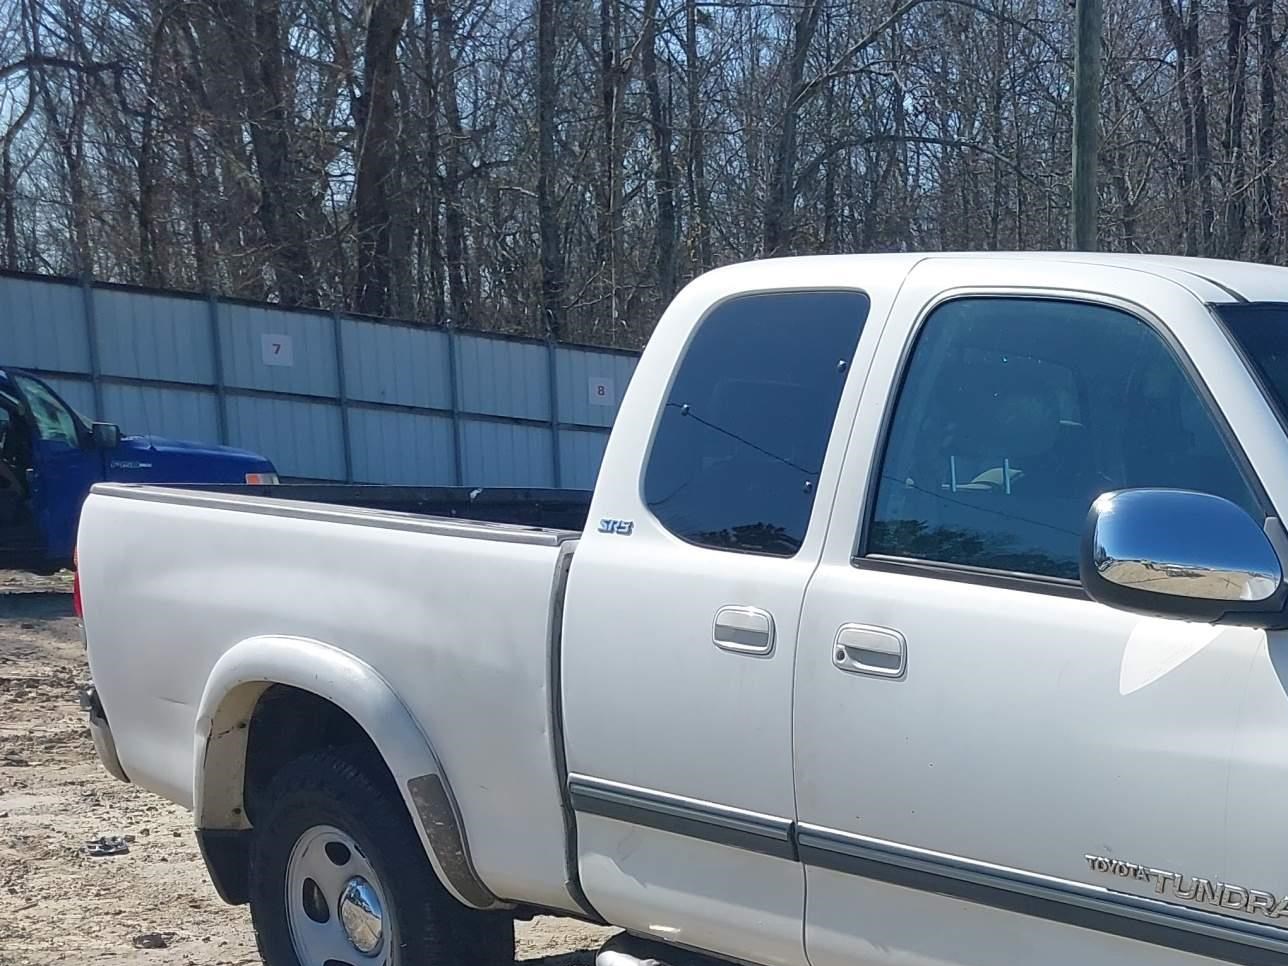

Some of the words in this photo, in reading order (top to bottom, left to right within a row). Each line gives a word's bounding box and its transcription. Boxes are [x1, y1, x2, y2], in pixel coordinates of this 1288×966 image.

[271, 343, 281, 355] 7
[597, 385, 605, 396] 8
[1084, 853, 1151, 882] TOYOTA
